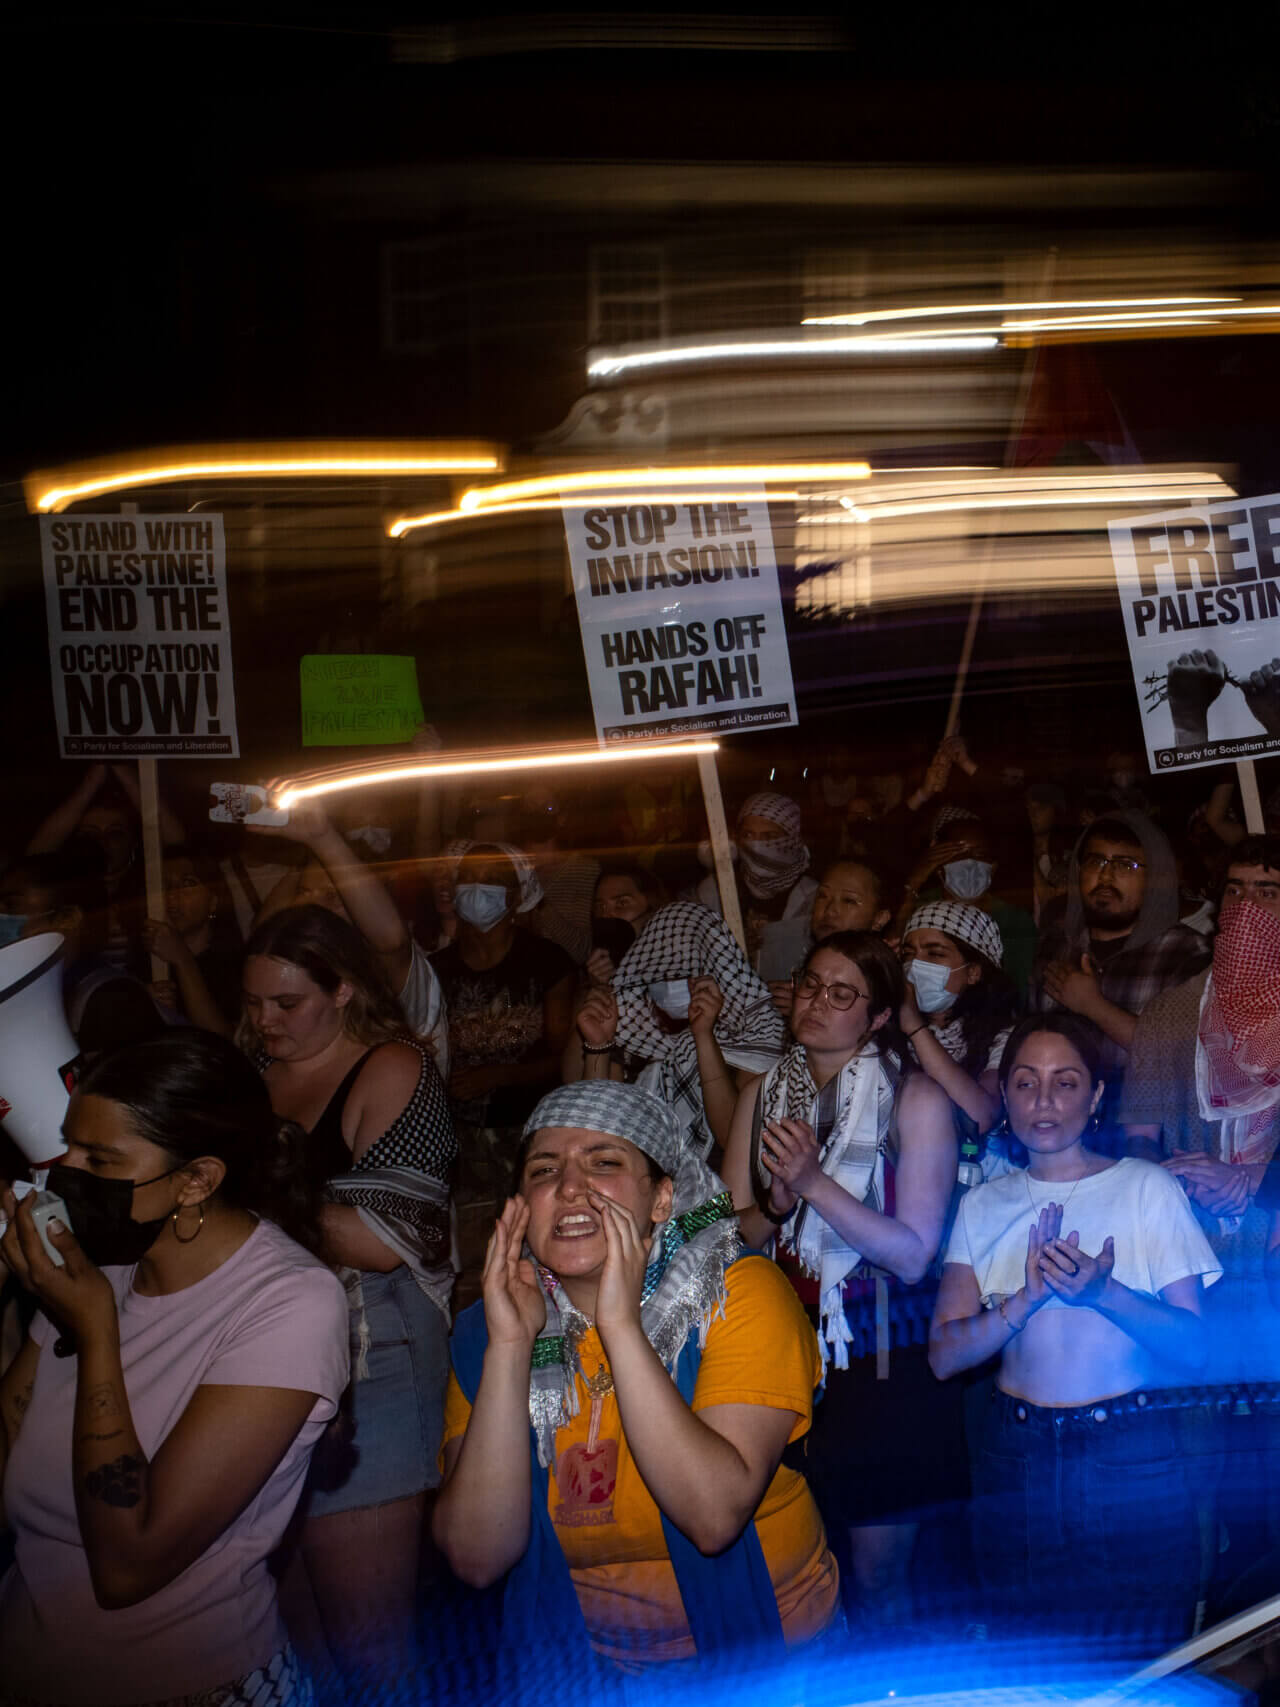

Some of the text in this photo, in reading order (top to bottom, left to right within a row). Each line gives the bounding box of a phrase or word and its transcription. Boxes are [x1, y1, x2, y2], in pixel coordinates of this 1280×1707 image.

[51, 520, 213, 552] STAND WITH
[583, 502, 753, 550] STOP THE
[55, 554, 215, 586] PALESTINE!
[587, 540, 760, 597] INVASION!
[58, 587, 221, 631] END THE
[60, 643, 220, 673] OCCUPATION
[601, 614, 766, 668] HANDS OFF
[618, 654, 763, 715] RAFAH!
[64, 673, 222, 735] NOW!
[627, 711, 787, 740] Party for Socialism and Liberation
[83, 740, 229, 753] Party for Socialism and Liberation
[1177, 749, 1201, 762] Party
[1203, 747, 1217, 757] for
[1219, 742, 1264, 755] Socialism
